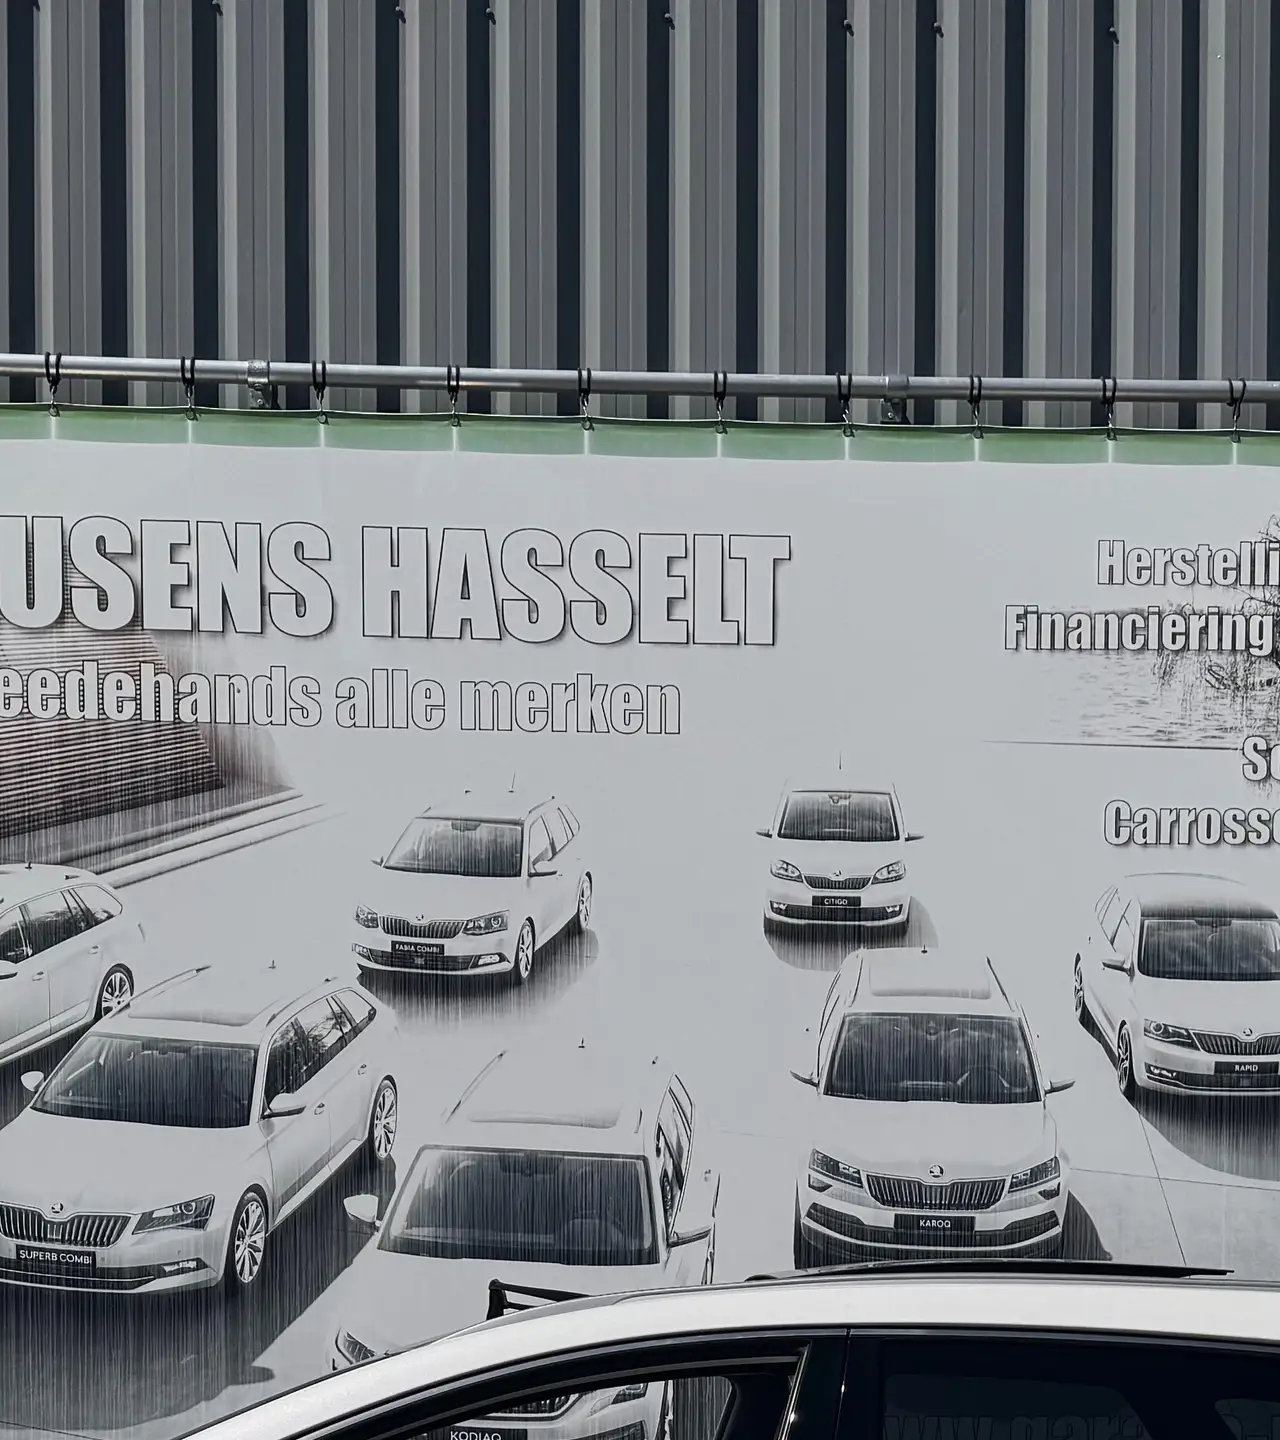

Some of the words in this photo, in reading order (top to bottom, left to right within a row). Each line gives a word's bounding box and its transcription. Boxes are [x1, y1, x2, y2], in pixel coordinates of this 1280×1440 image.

[362, 526, 791, 646] HASSELT
[1004, 605, 1273, 656] Financiering
[336, 668, 445, 730] alle
[461, 673, 681, 734] merken
[920, 1219, 951, 1228] KAROQ
[20, 1250, 58, 1261] SUPERB
[59, 1253, 92, 1264] COMBI
